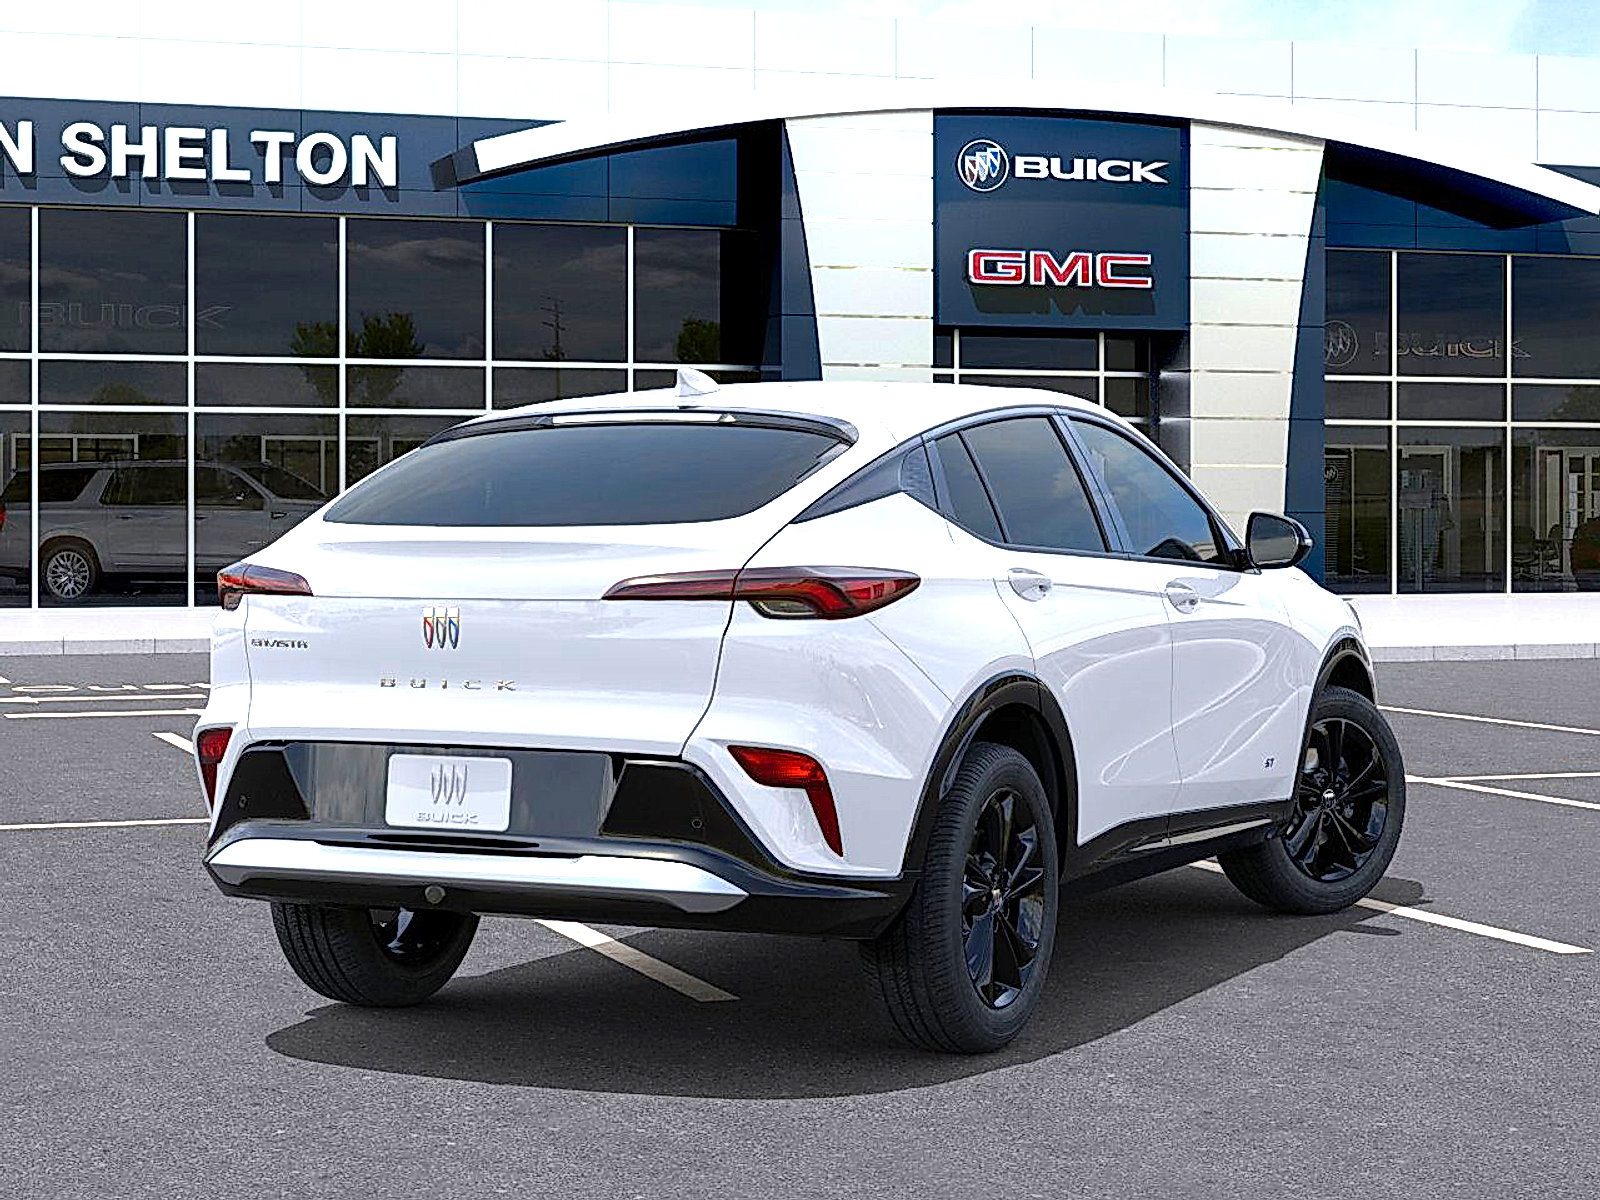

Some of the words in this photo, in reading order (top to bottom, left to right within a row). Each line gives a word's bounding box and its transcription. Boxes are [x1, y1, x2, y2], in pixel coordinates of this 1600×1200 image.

[60, 121, 398, 187] SHELTON
[1014, 155, 1169, 184] BUICK
[968, 250, 1152, 289] GMC
[19, 301, 231, 330] BUICK
[416, 812, 479, 824] BUICK
